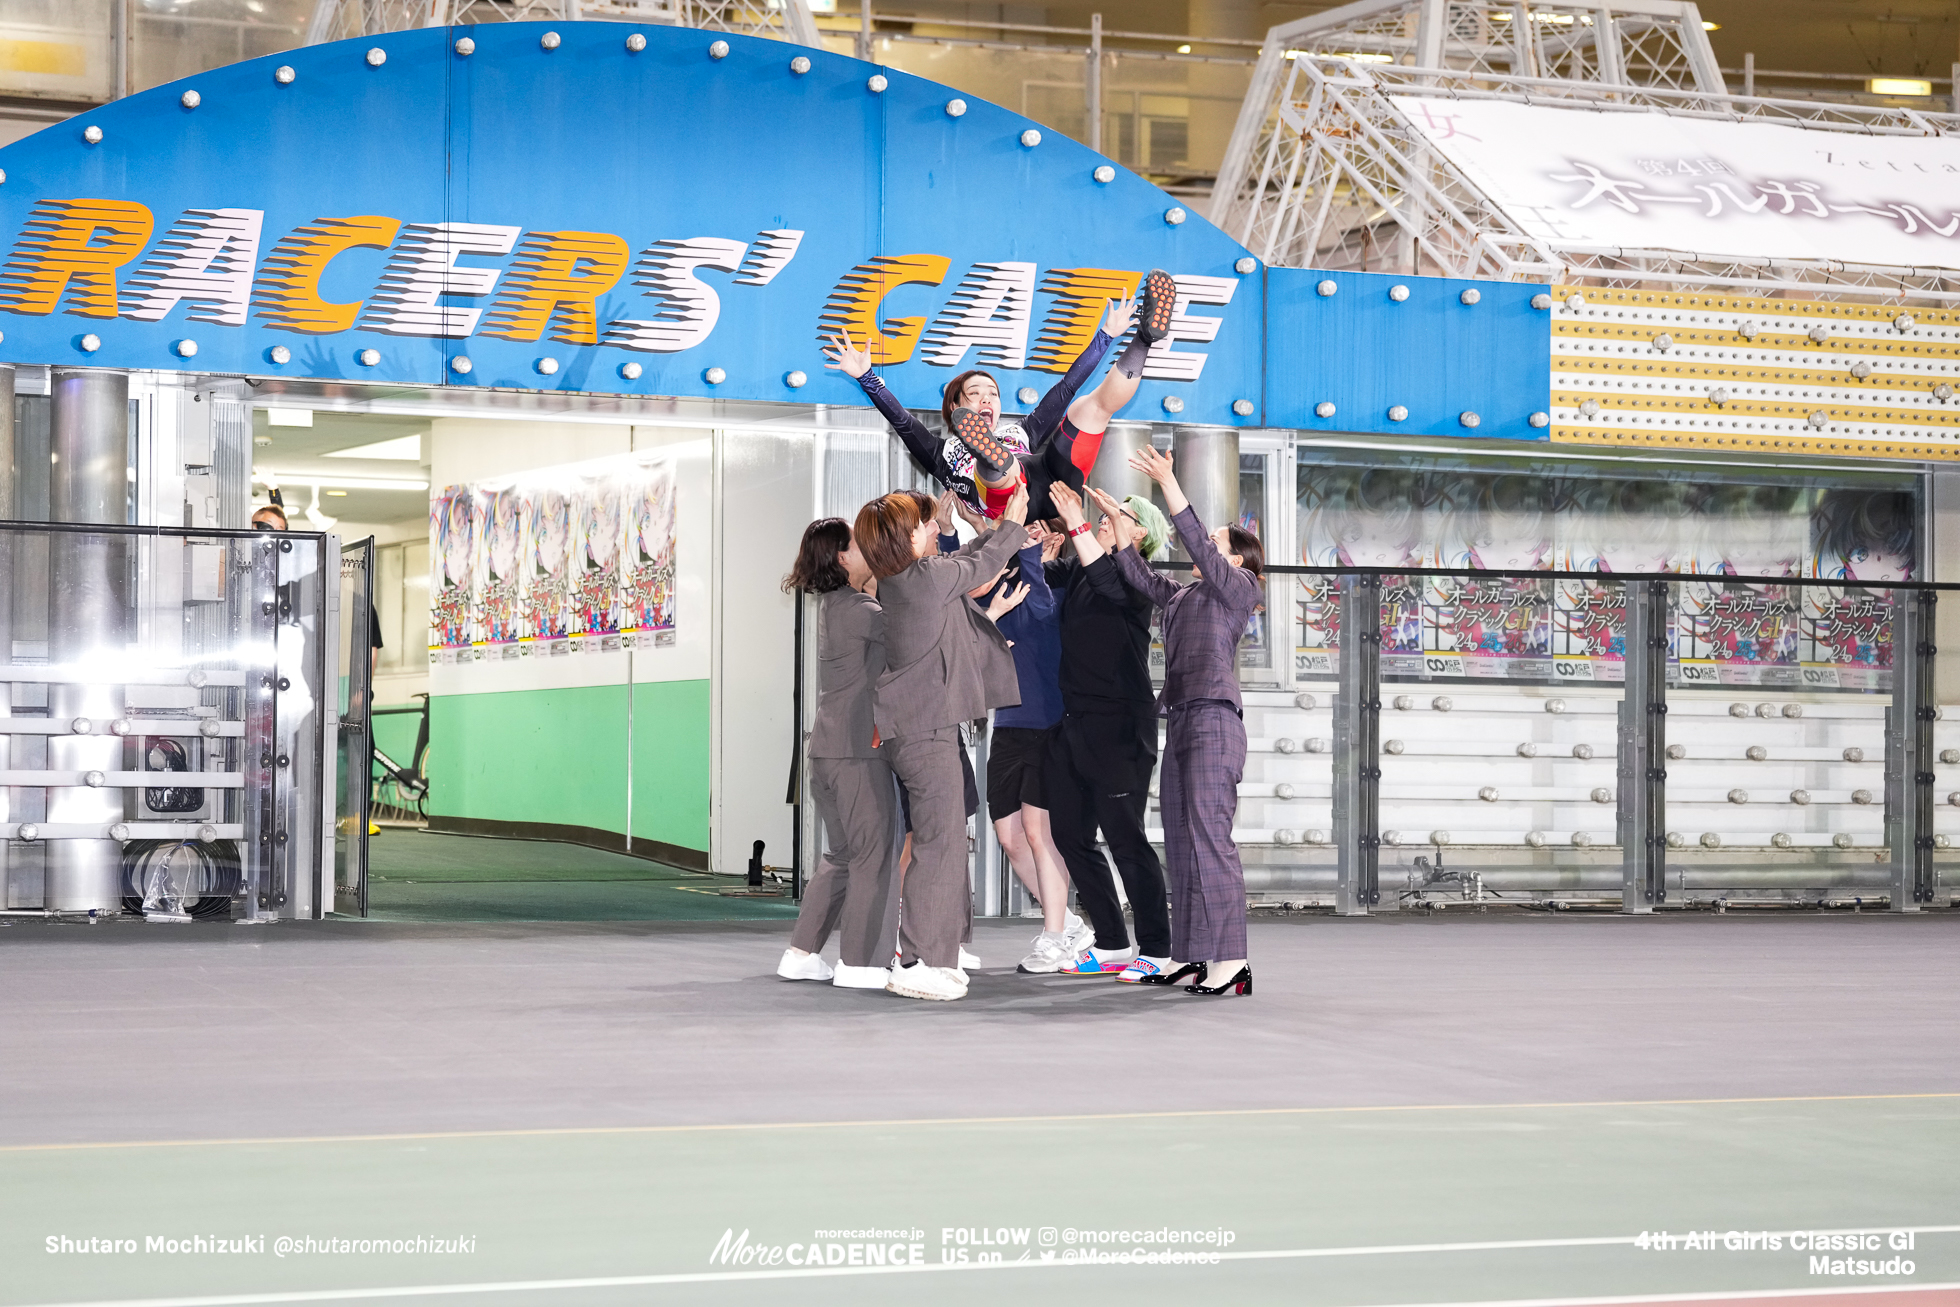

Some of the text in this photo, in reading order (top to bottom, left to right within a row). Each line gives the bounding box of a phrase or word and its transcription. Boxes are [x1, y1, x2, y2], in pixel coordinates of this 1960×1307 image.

[1636, 158, 1736, 178] 第4回
[1549, 161, 1960, 238] オールガール
[0, 197, 1240, 381] RACERS' GATE
[1446, 585, 1539, 607] オールガールズ
[1702, 594, 1788, 616] オールガールズ
